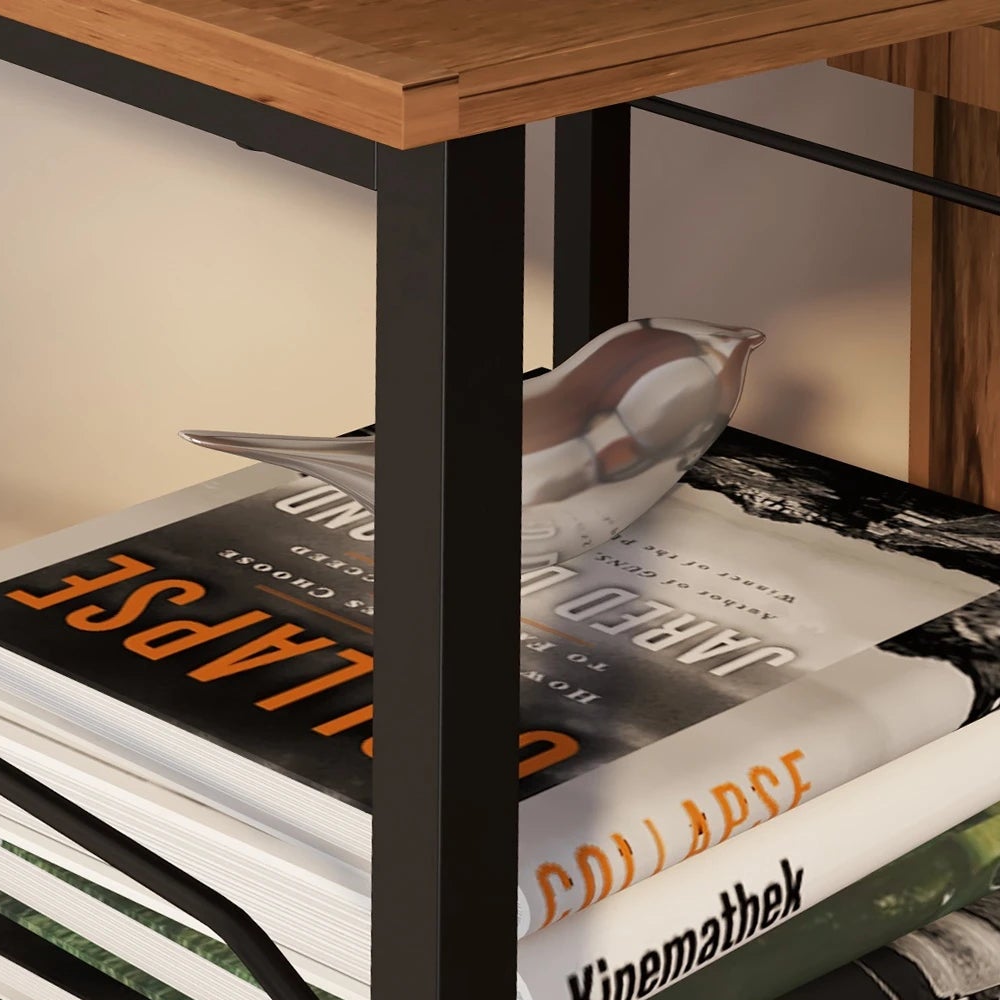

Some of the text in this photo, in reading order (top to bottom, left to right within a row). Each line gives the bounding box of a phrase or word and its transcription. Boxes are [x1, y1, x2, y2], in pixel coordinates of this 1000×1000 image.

[644, 544, 796, 604] Winner of the
[661, 577, 690, 589] of
[698, 590, 777, 620] Author
[555, 587, 797, 677] JARED
